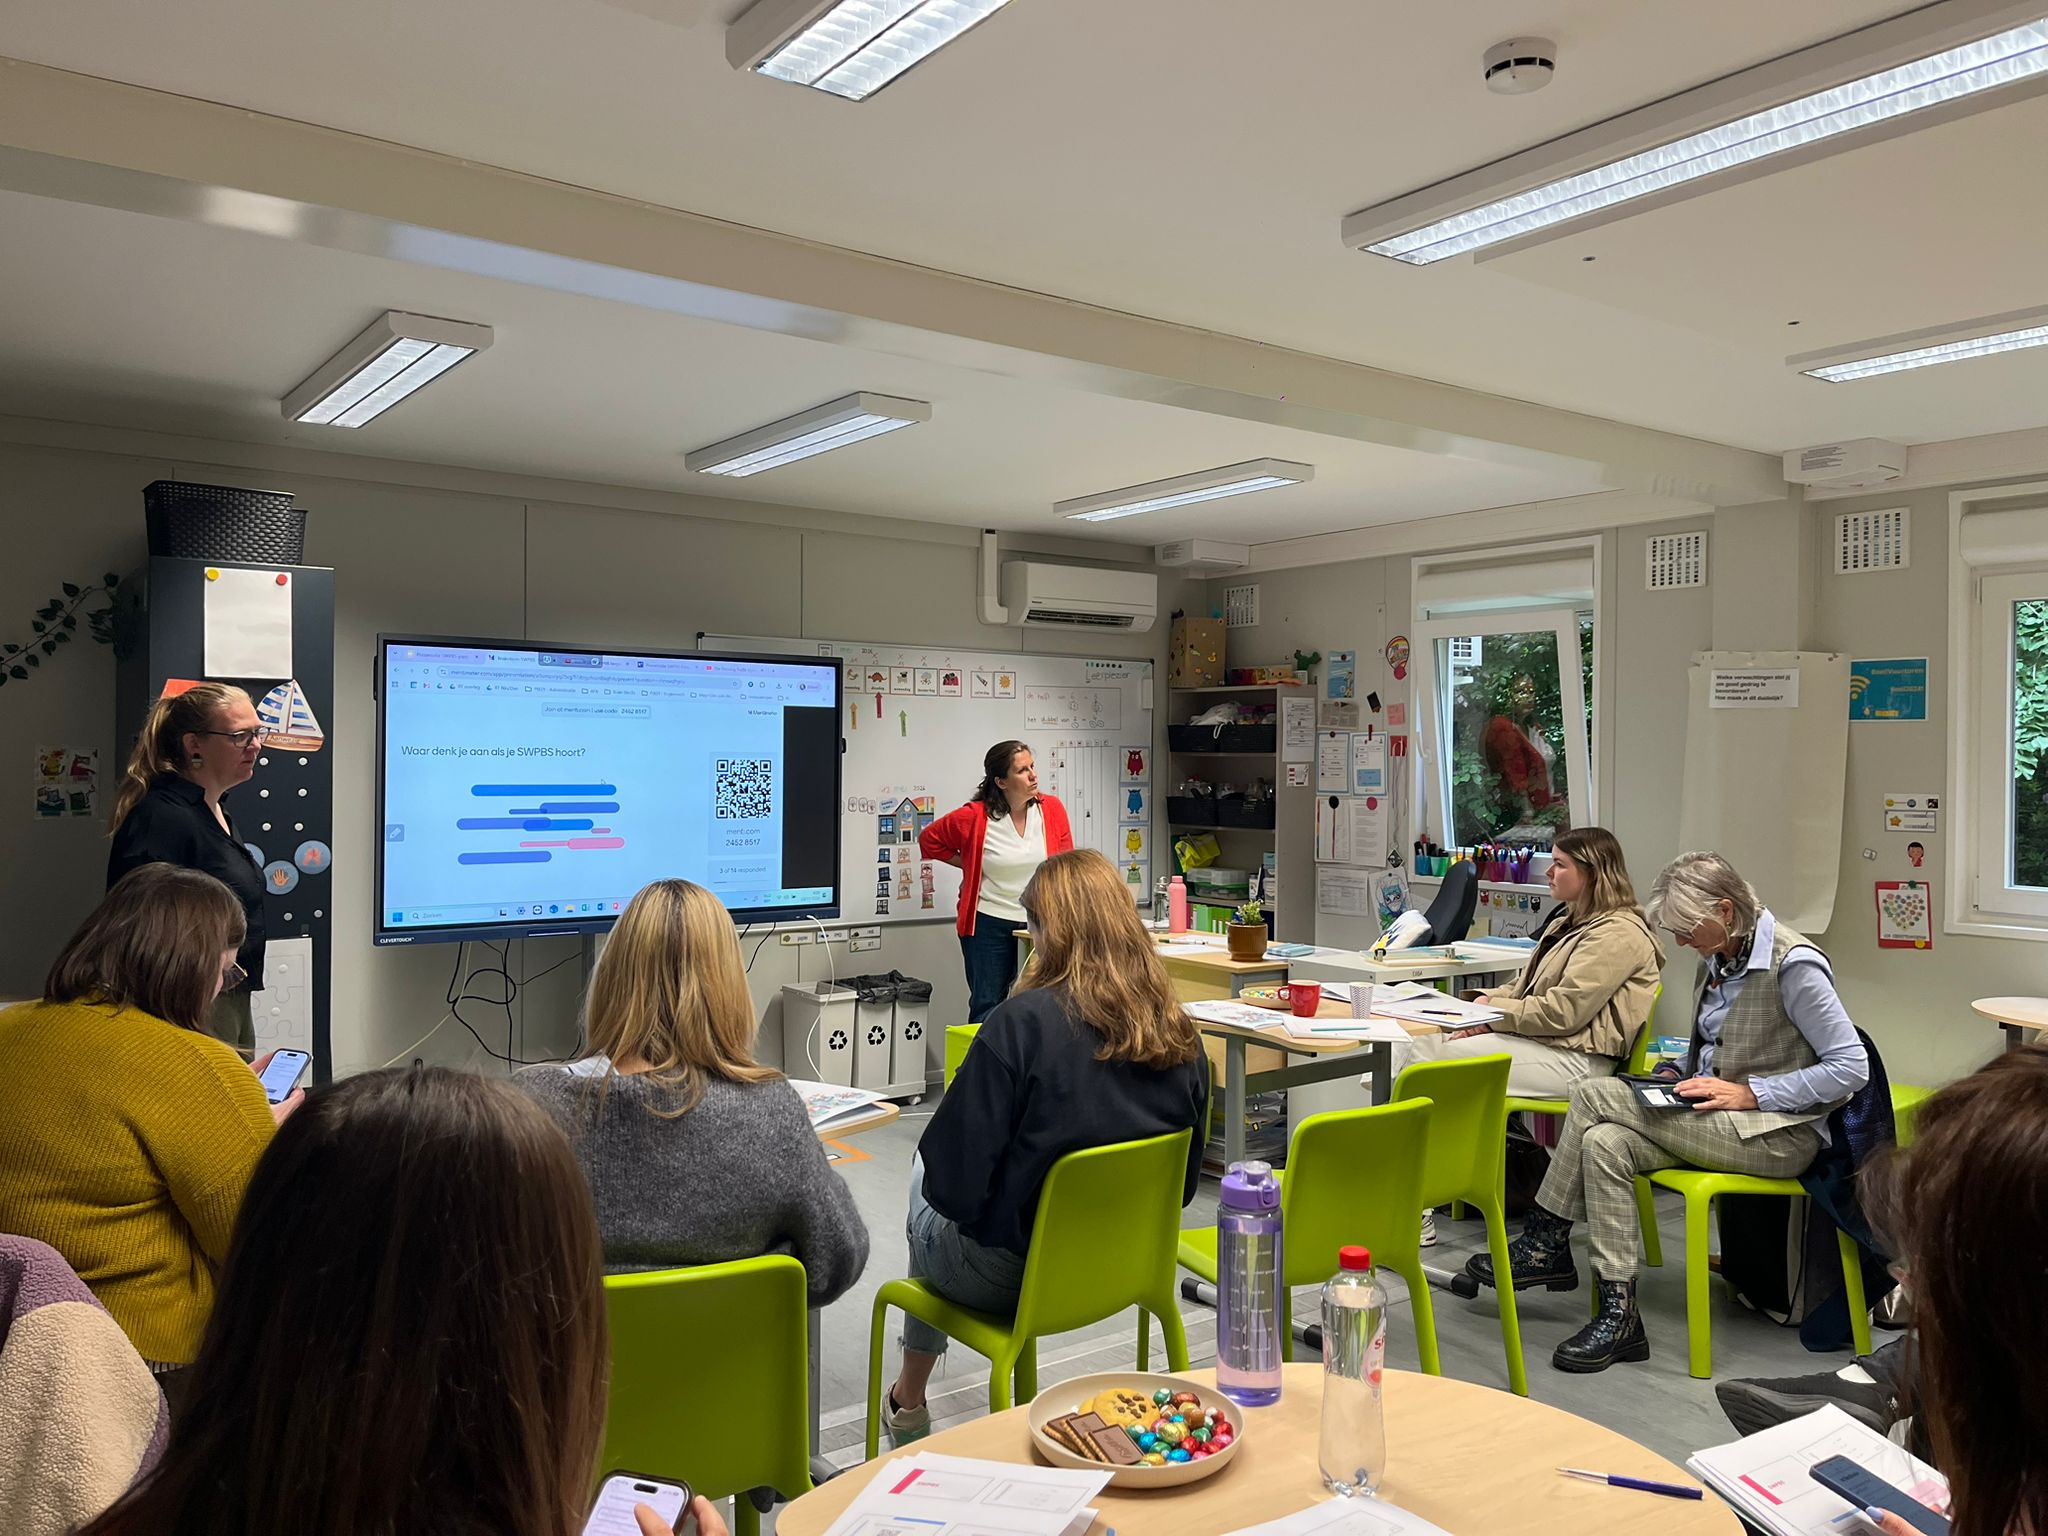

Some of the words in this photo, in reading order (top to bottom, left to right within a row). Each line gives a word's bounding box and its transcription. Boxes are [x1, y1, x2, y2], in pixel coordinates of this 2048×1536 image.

[401, 746, 430, 755] Waar
[432, 747, 456, 756] denk
[458, 747, 467, 757] je
[469, 748, 490, 756] aan
[491, 748, 504, 756] als
[505, 748, 515, 758] je
[517, 748, 553, 757] SWPBS
[555, 748, 586, 757] hoort?
